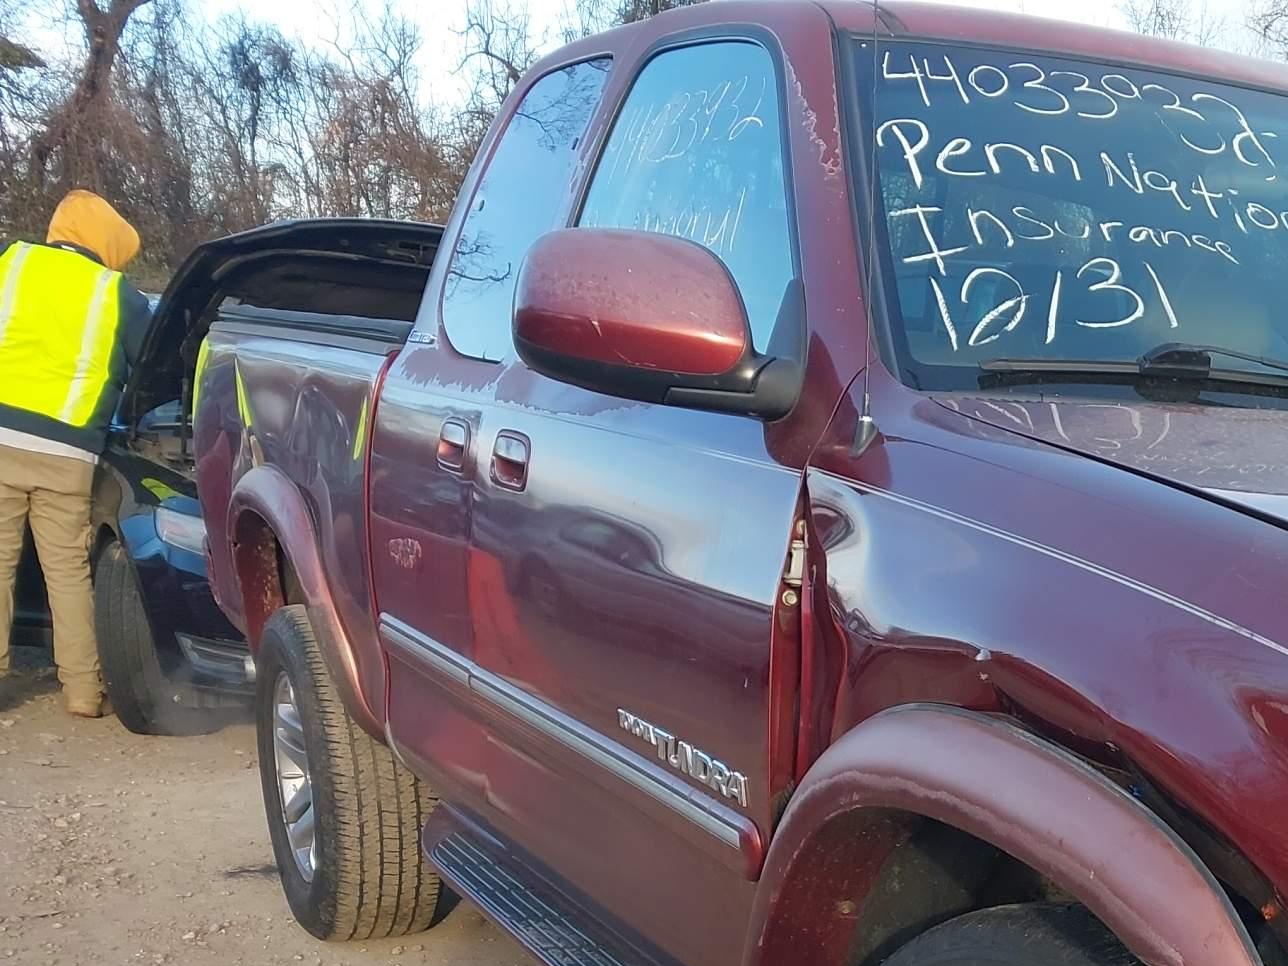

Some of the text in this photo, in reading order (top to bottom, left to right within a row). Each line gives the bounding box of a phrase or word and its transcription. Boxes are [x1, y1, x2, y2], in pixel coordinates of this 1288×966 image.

[876, 118, 1081, 190] Penn
[890, 203, 1240, 277] Insurance
[654, 727, 750, 807] TUNDRA
